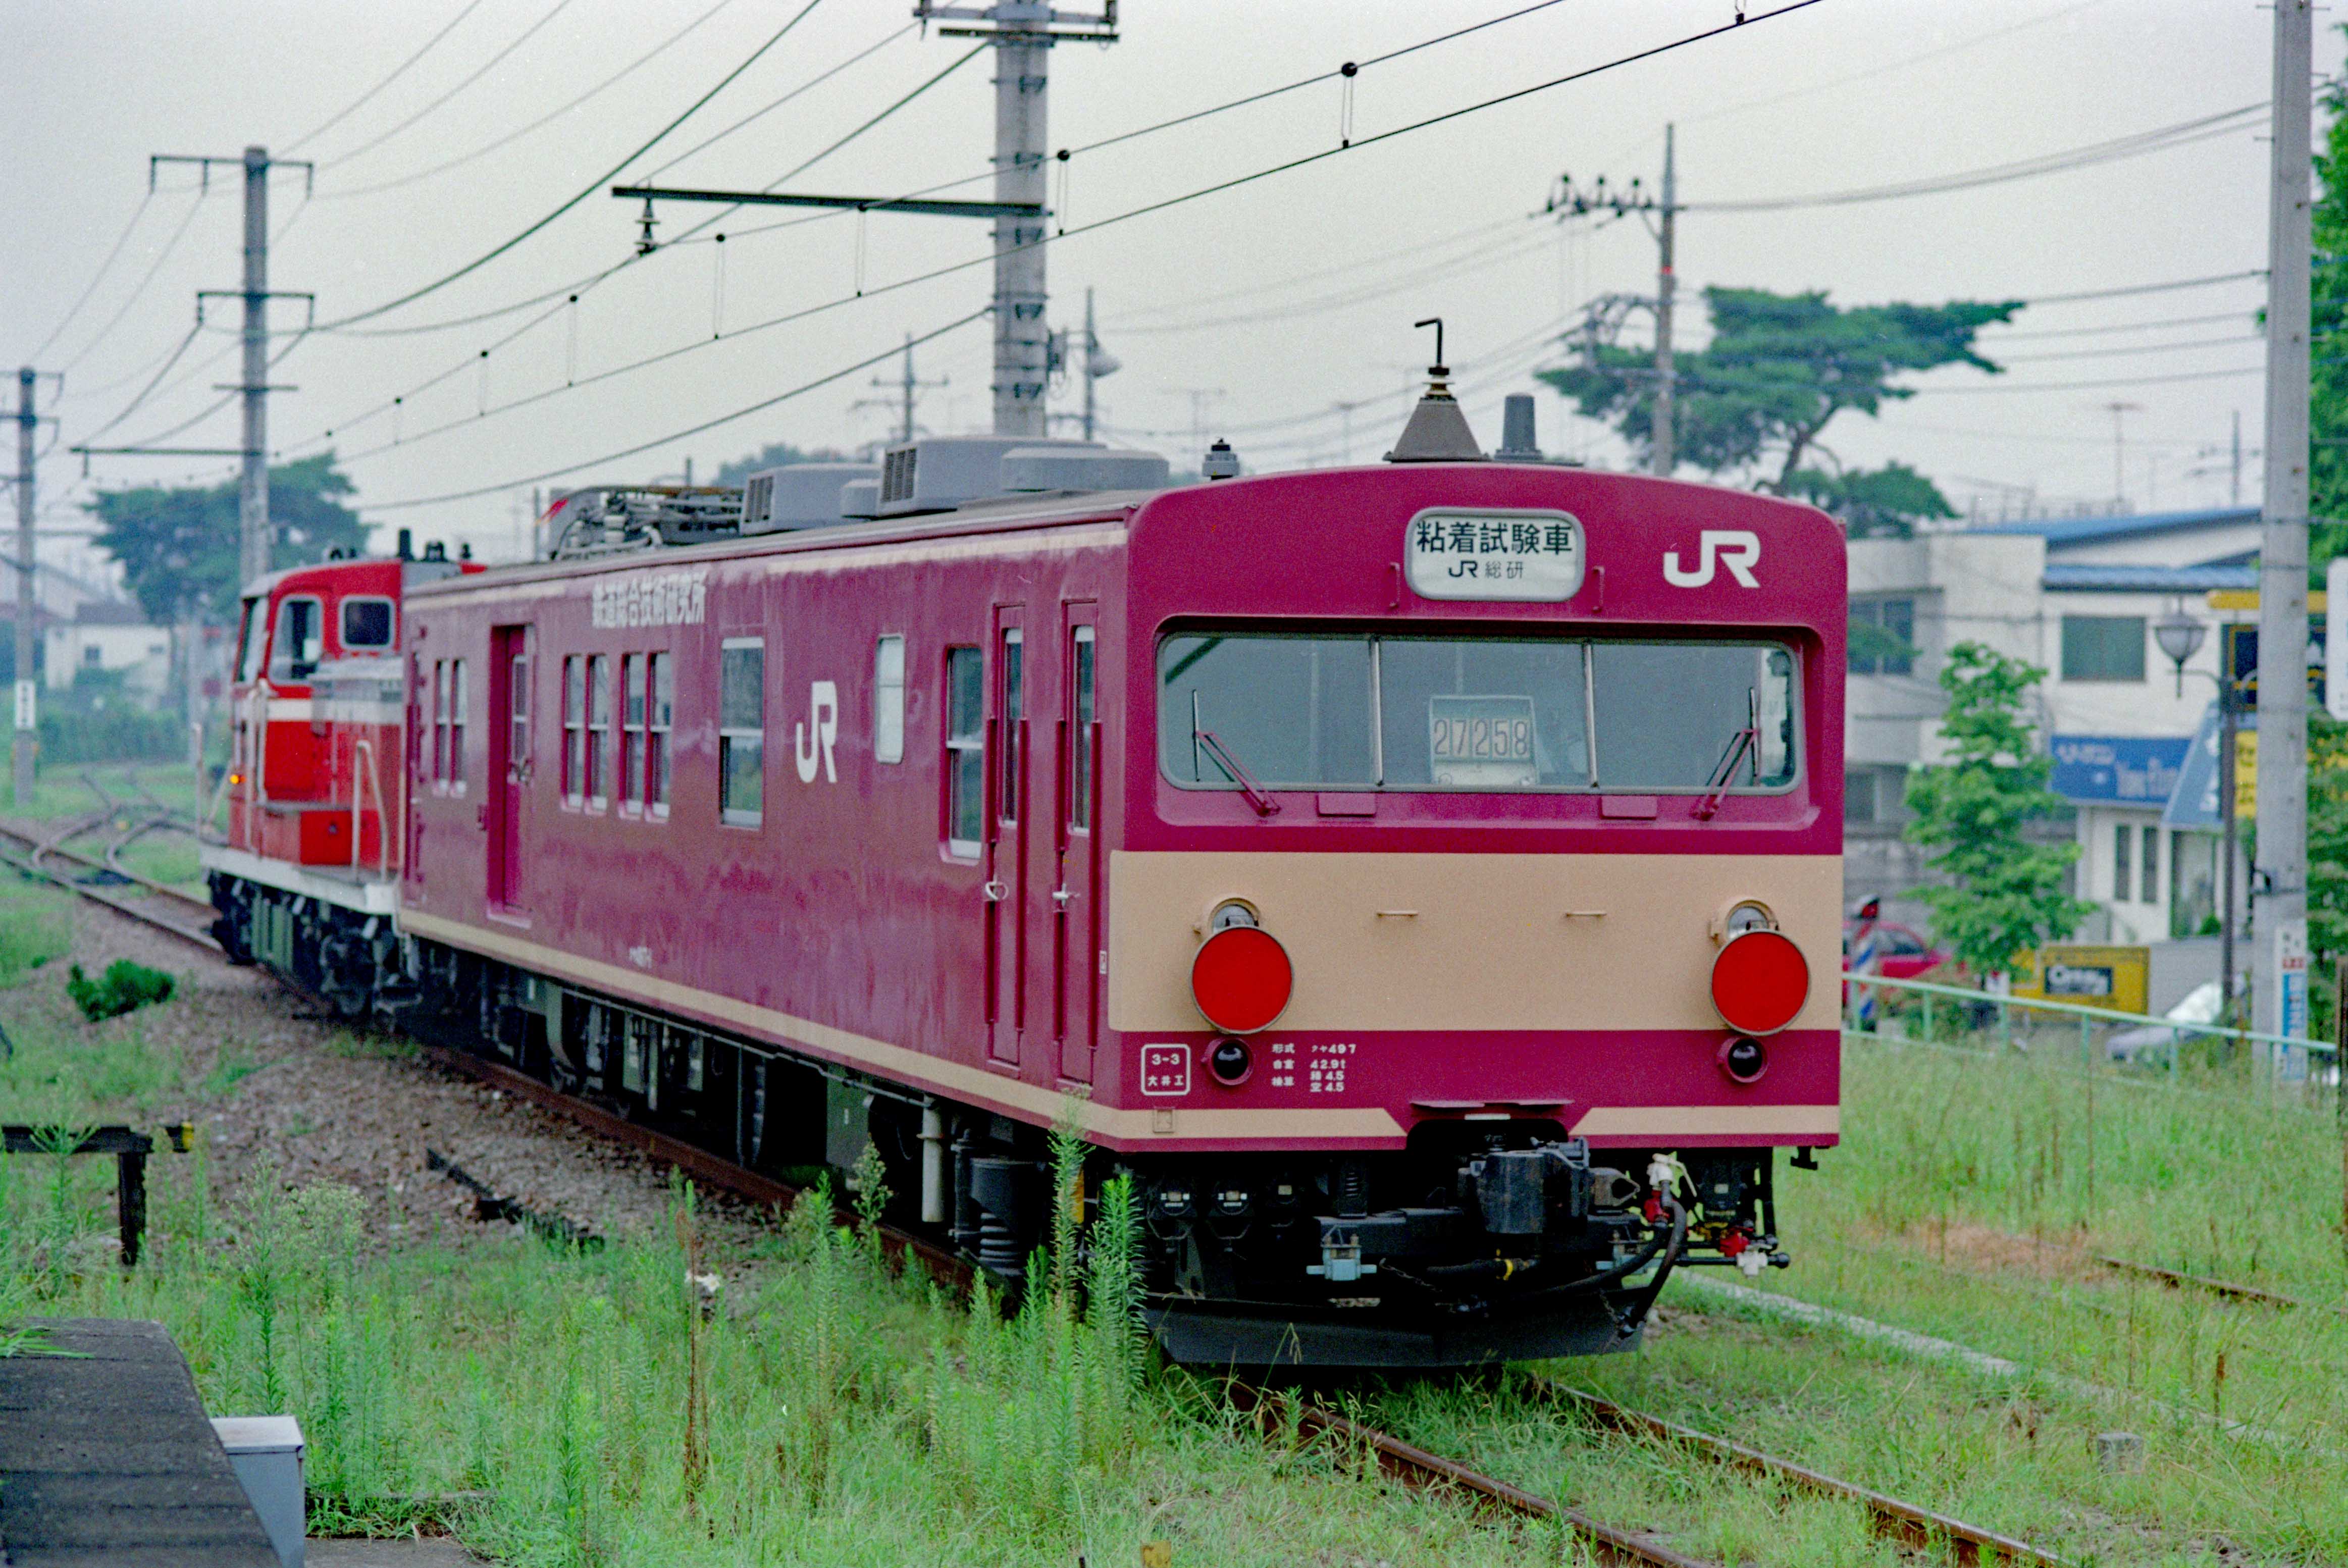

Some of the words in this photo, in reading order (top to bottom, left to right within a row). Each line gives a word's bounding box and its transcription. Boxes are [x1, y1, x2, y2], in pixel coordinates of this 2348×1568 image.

[1417, 521, 1573, 555] 粘着試験車
[1663, 531, 1761, 588] JR
[1449, 561, 1478, 578] JR
[1485, 561, 1524, 579] 総研
[796, 681, 838, 783] JR
[1434, 719, 1527, 756] 27258
[1152, 1053, 1180, 1066] 3-3
[1147, 1075, 1184, 1087] 大井工
[1325, 1070, 1344, 1081] 4.5
[1325, 1082, 1344, 1092] 4.5
